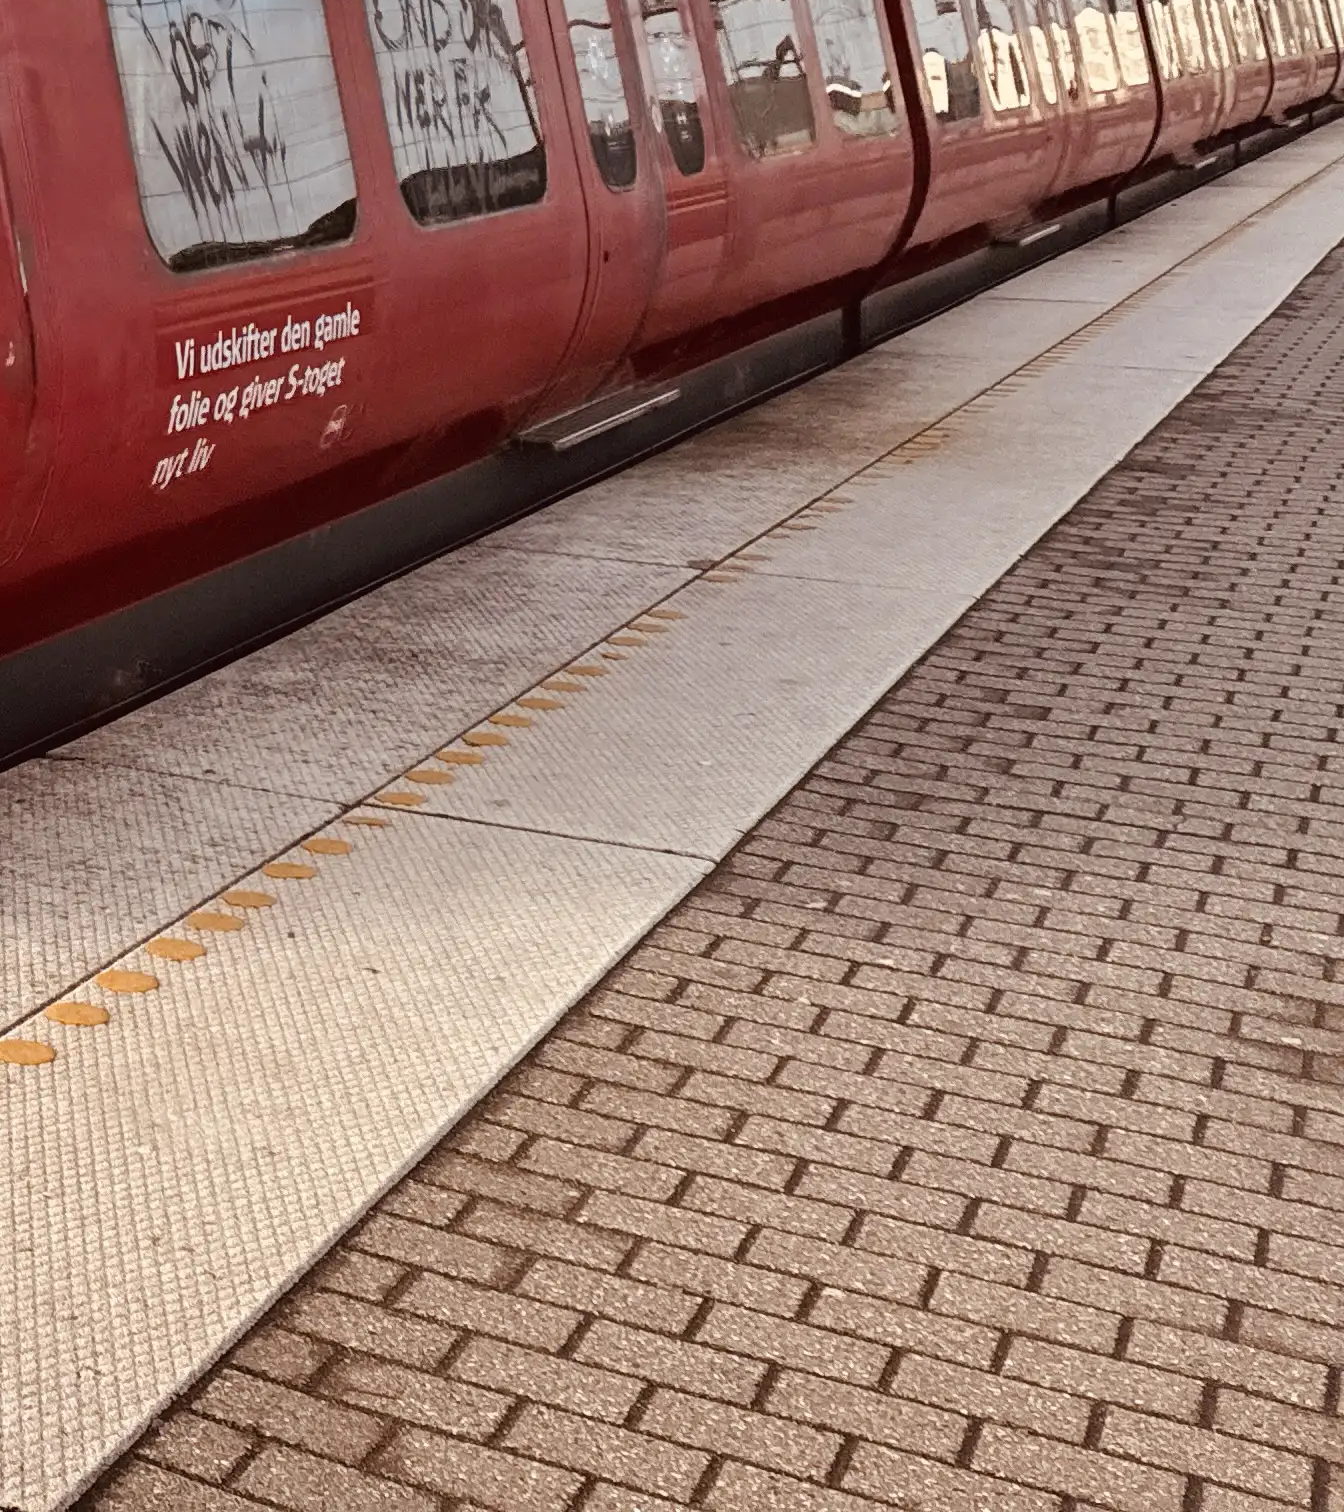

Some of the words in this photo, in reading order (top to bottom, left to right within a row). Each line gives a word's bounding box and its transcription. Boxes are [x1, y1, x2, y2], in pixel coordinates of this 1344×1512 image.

[175, 338, 195, 380] Vi
[199, 322, 278, 374] udskifter
[280, 315, 311, 354] den
[314, 301, 361, 351] gamle
[167, 390, 210, 435] folie
[213, 386, 240, 424] og
[239, 375, 285, 420] giver
[284, 355, 346, 398] S-toget
[151, 446, 189, 490] nyt
[186, 437, 216, 475] liv
